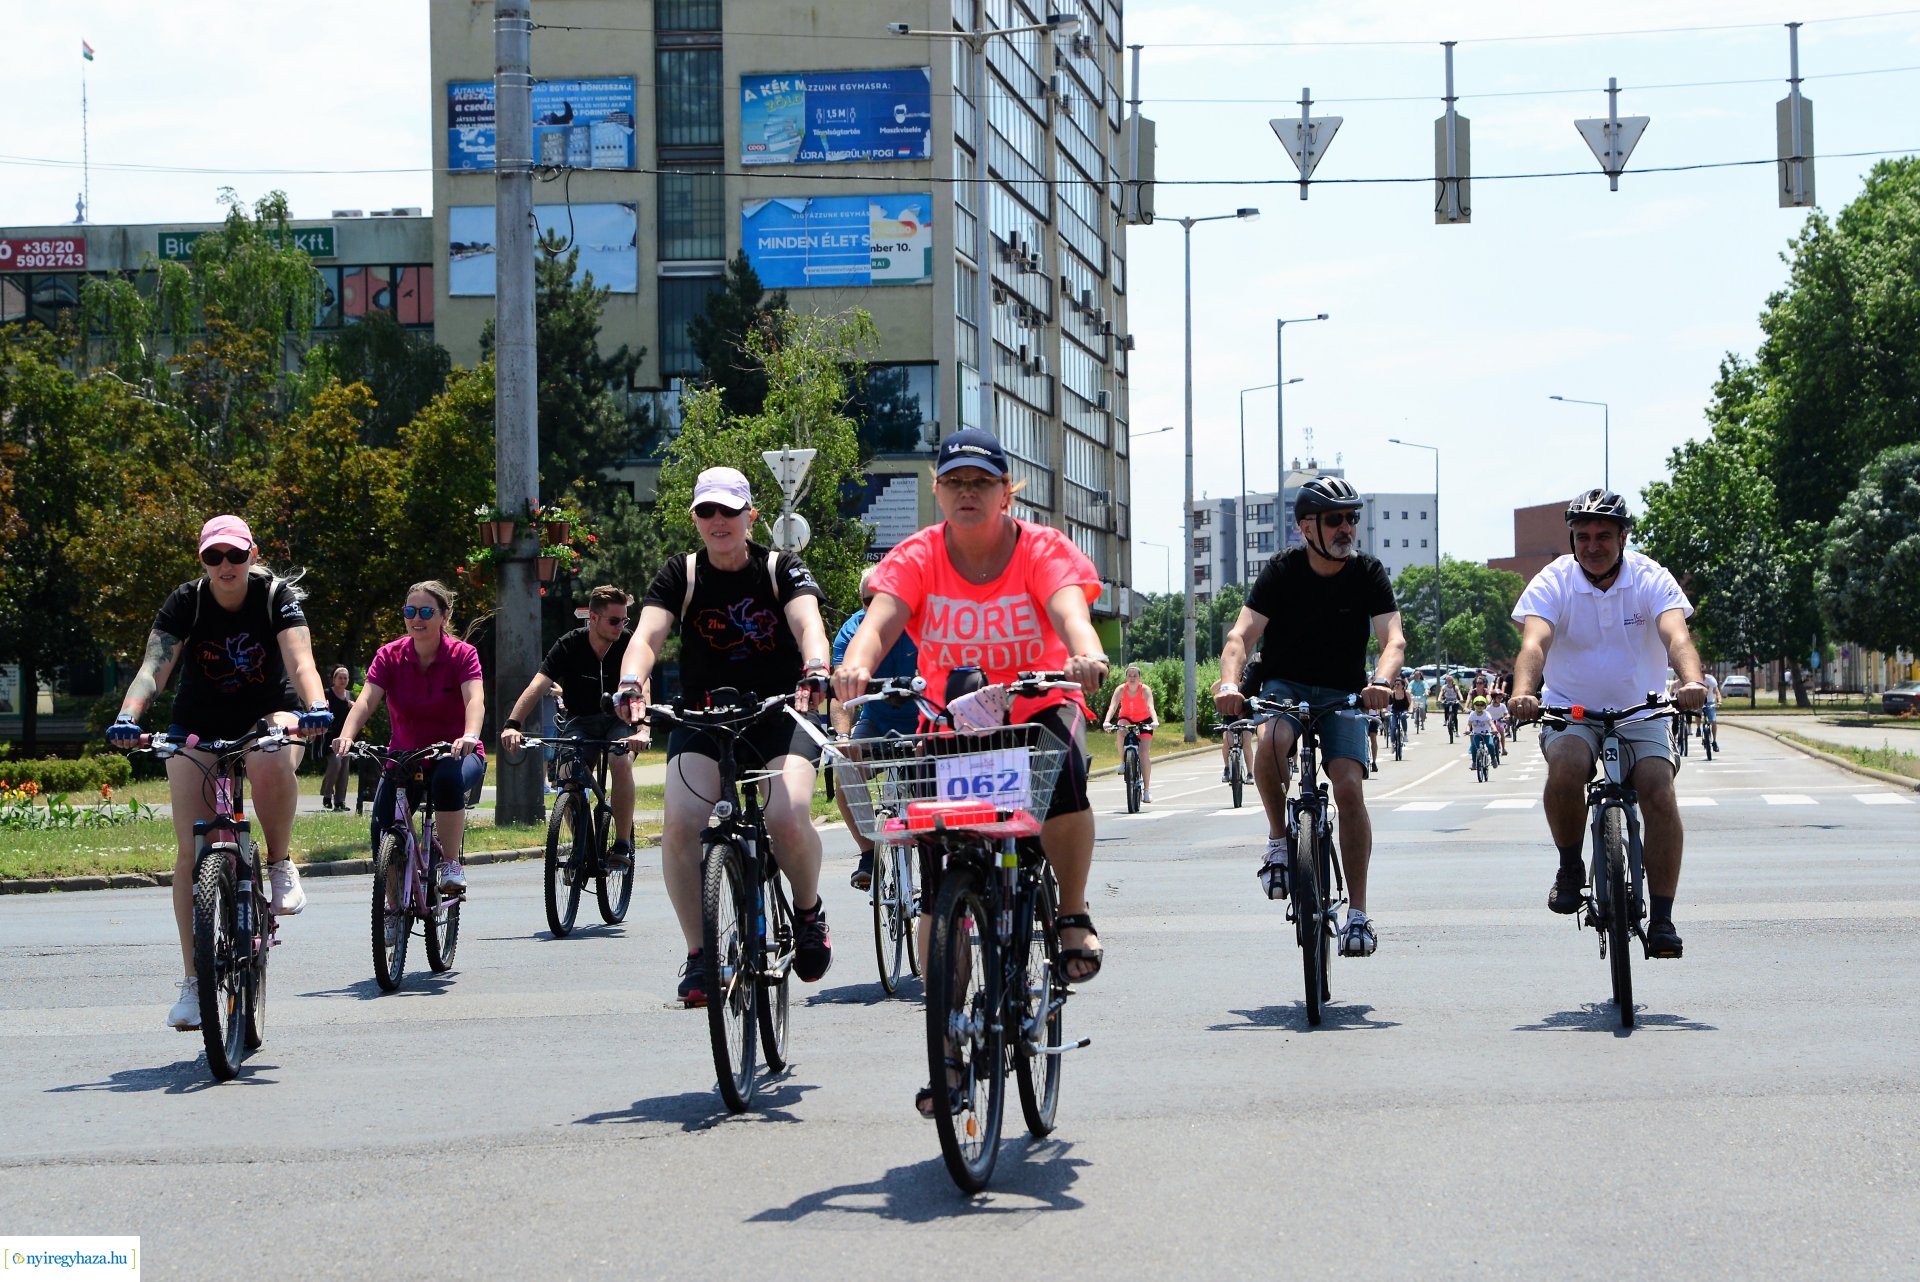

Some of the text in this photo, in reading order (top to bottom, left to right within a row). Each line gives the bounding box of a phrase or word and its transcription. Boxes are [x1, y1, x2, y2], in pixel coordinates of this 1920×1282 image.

[745, 89, 758, 103] A
[760, 79, 791, 97] KÉK
[838, 108, 846, 118] M
[800, 148, 824, 160] ÚJRA
[873, 148, 894, 158] FOG!
[22, 240, 75, 255] +36/20
[294, 233, 330, 251] Kft.
[759, 235, 818, 250] MINDEN
[821, 231, 859, 248] ÉLET
[896, 243, 911, 253] 10.
[16, 253, 84, 268] 5902743
[925, 600, 1036, 640] MORE
[919, 638, 1045, 670] CARDIO
[946, 768, 1020, 801] 062
